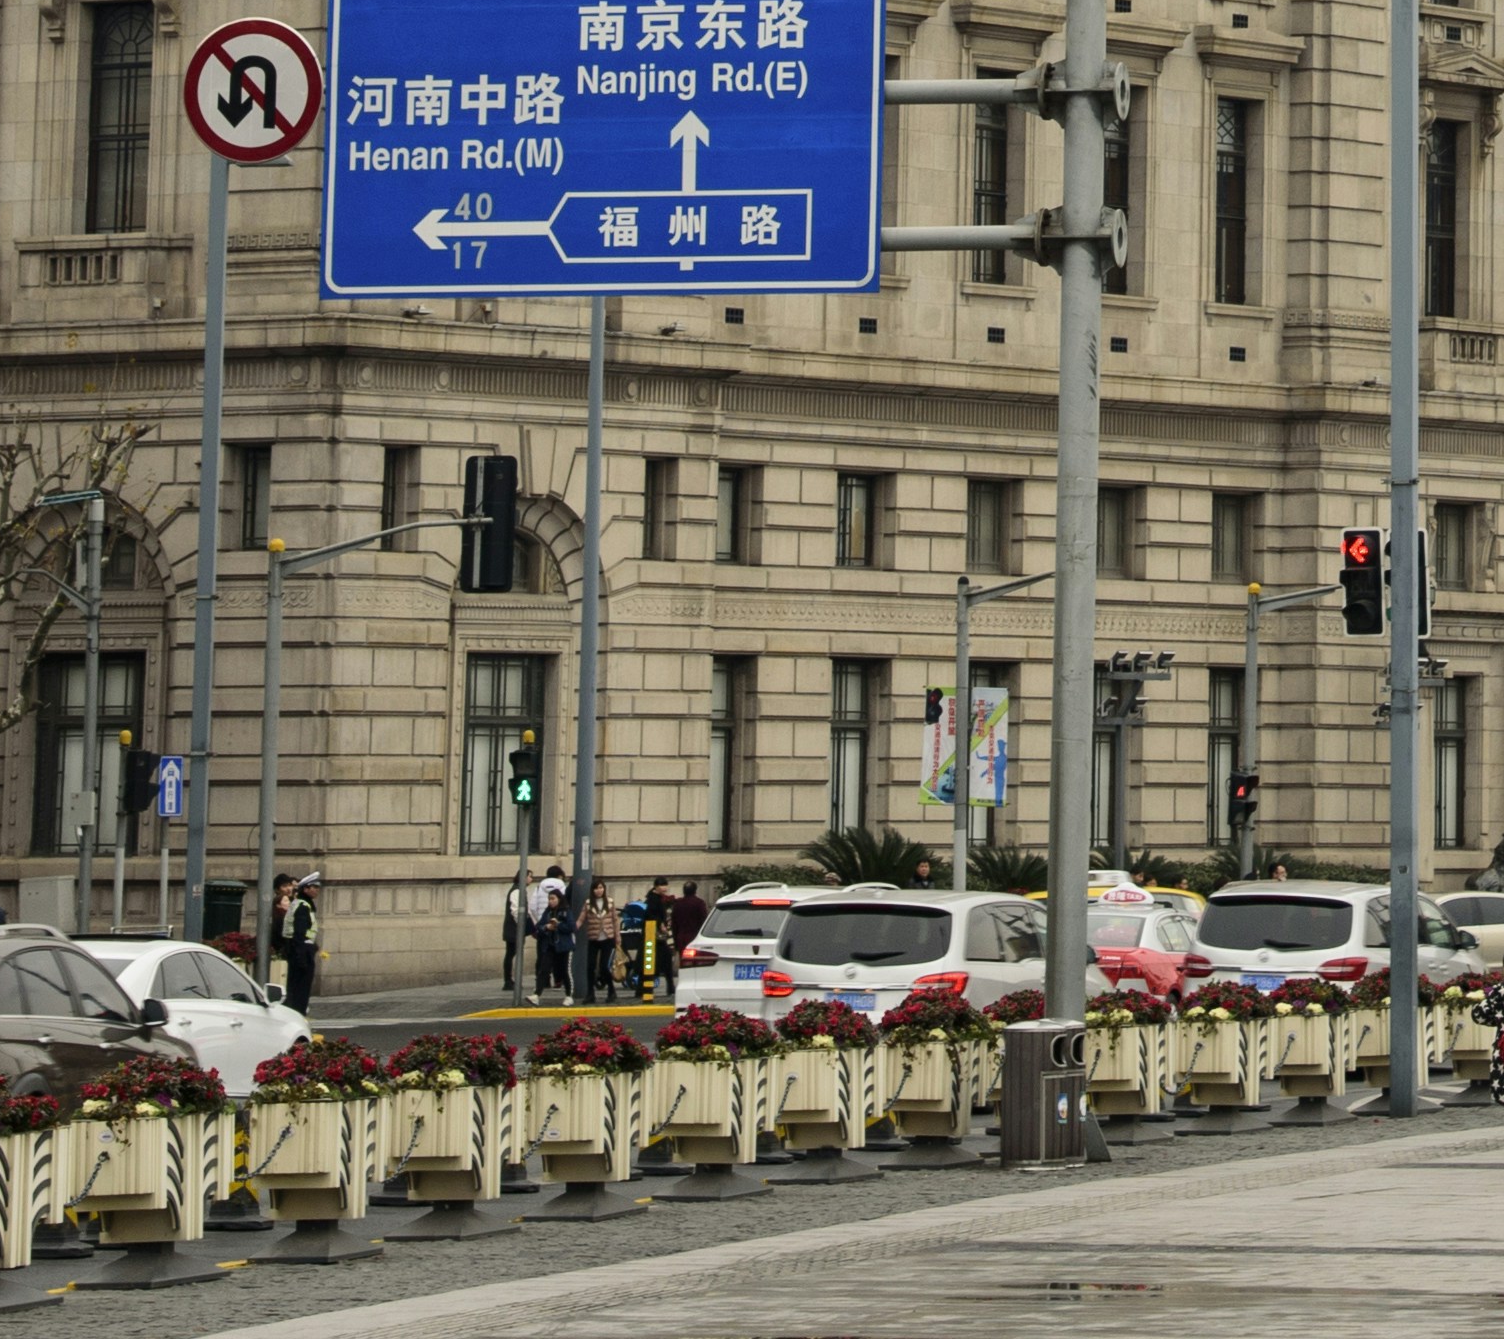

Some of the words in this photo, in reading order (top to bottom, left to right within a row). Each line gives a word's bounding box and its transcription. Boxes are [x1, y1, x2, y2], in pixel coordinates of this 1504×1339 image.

[347, 73, 565, 127] 河南中路
[577, 65, 696, 101] Nanjing
[712, 61, 808, 99] Rd.(E)
[348, 140, 449, 172] Henan
[461, 138, 564, 175] Rd.(M)
[455, 193, 493, 221] 40
[598, 204, 782, 248] 福州路
[452, 241, 487, 270] 17
